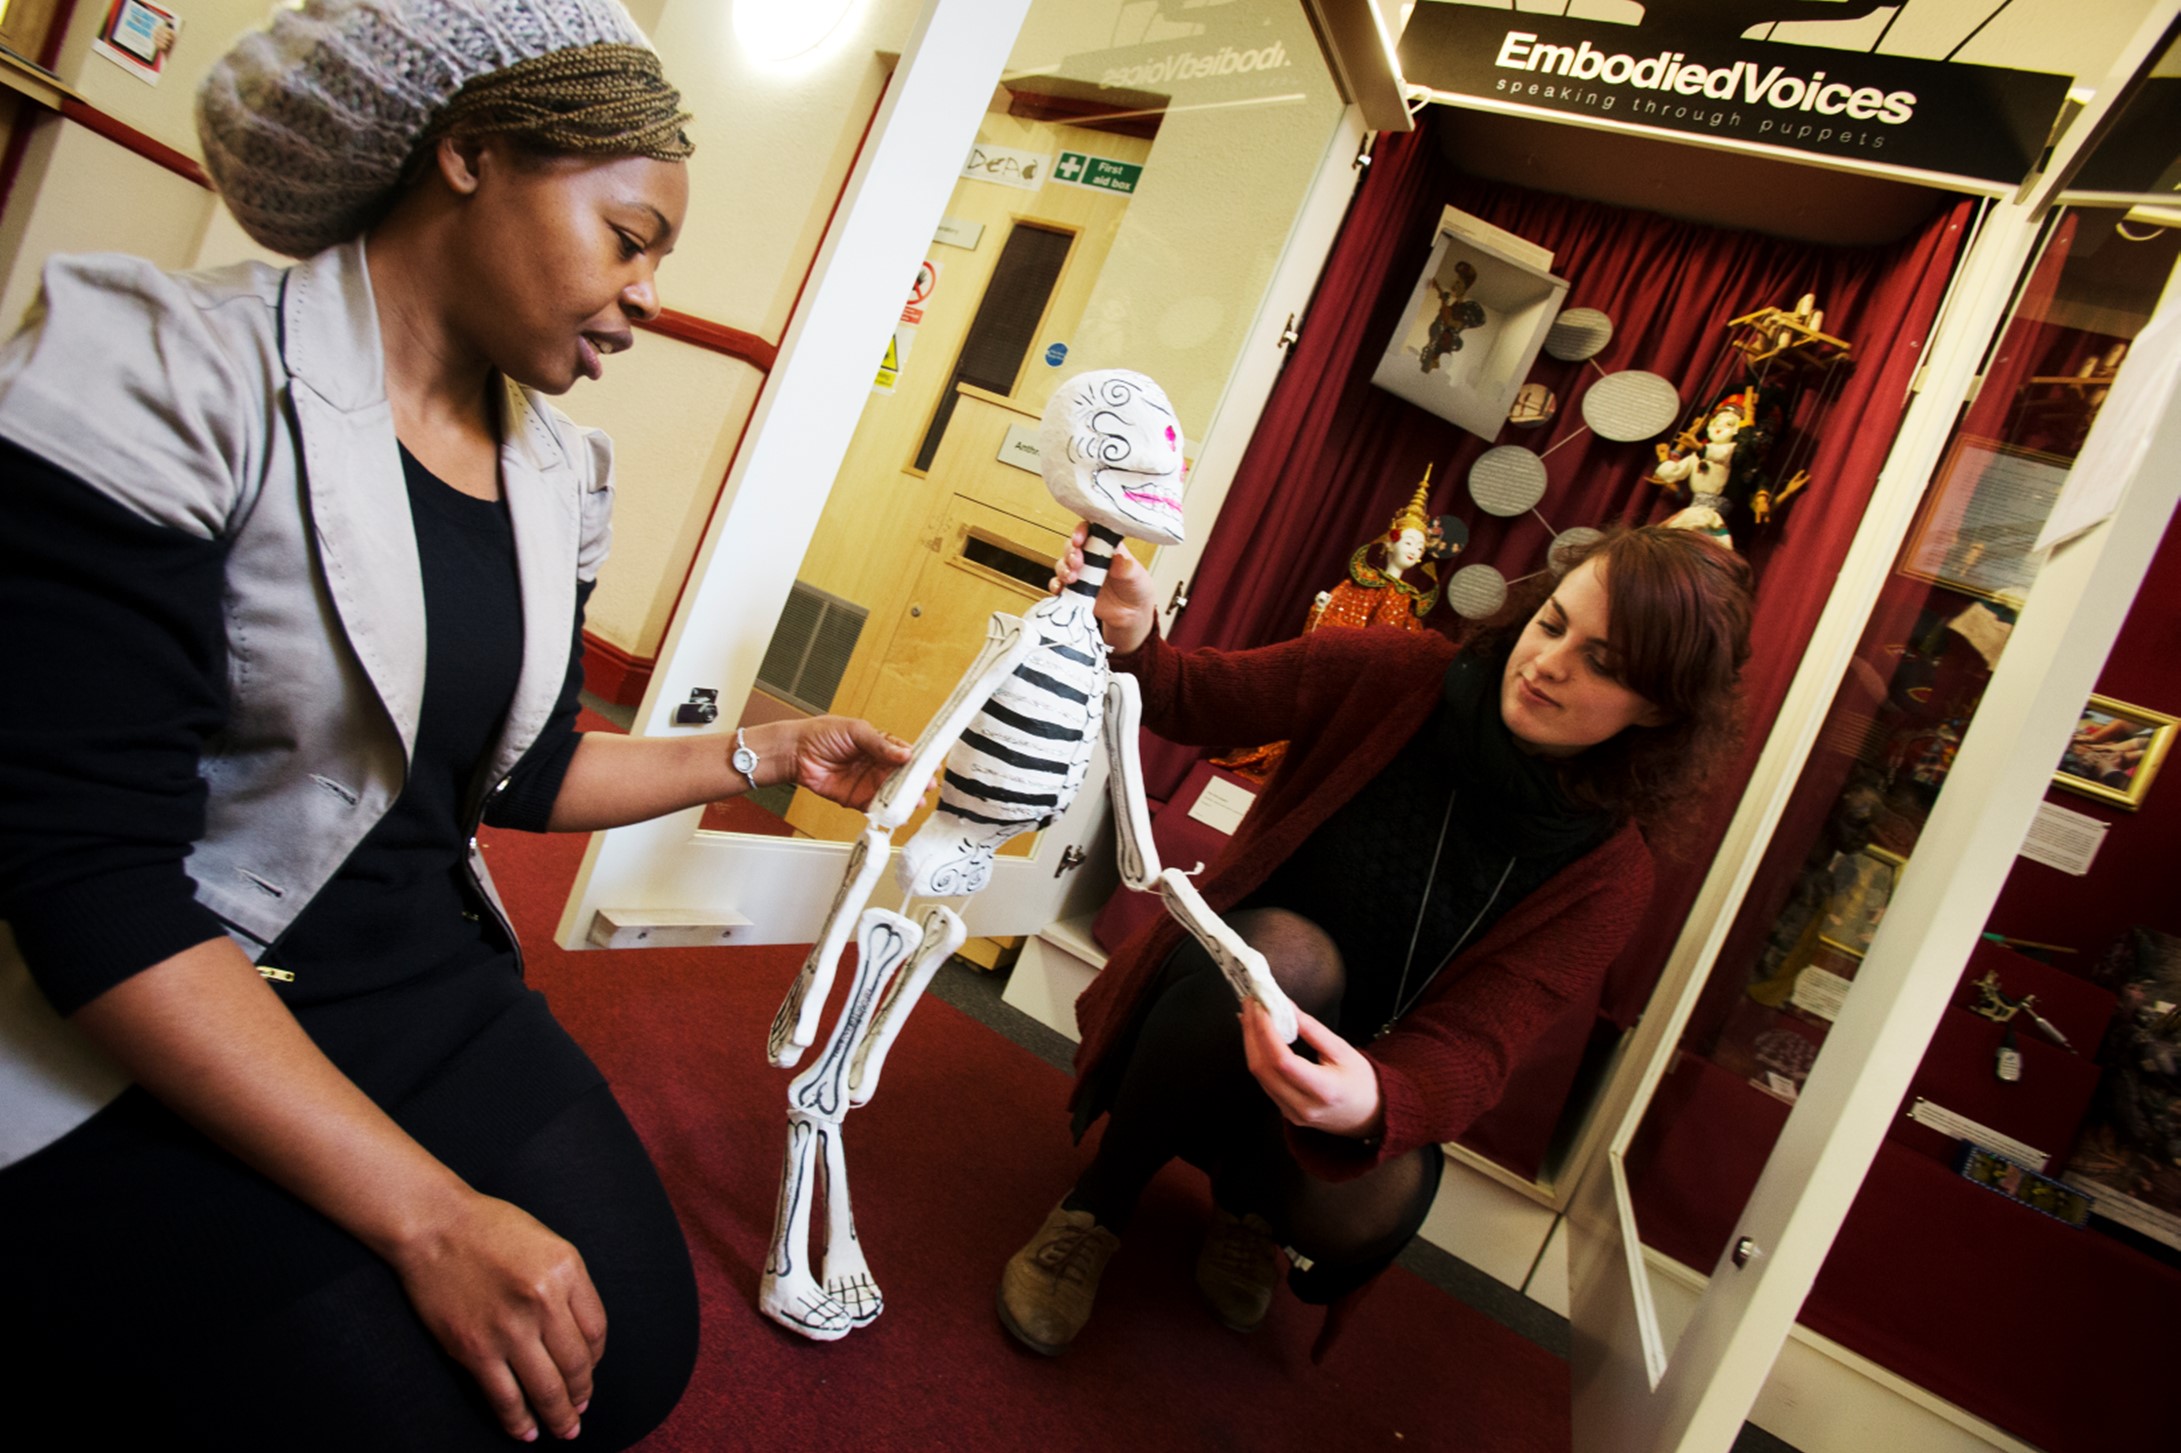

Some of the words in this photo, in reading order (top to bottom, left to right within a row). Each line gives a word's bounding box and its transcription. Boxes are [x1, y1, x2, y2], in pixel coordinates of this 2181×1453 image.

[1494, 30, 1918, 125] EmbodiedVoices
[1496, 78, 1616, 110] speaking
[1632, 97, 1742, 127] through
[1758, 118, 1886, 148] puppets
[1092, 176, 1111, 186] aid
[1111, 178, 1132, 190] box
[1098, 161, 1124, 175] First
